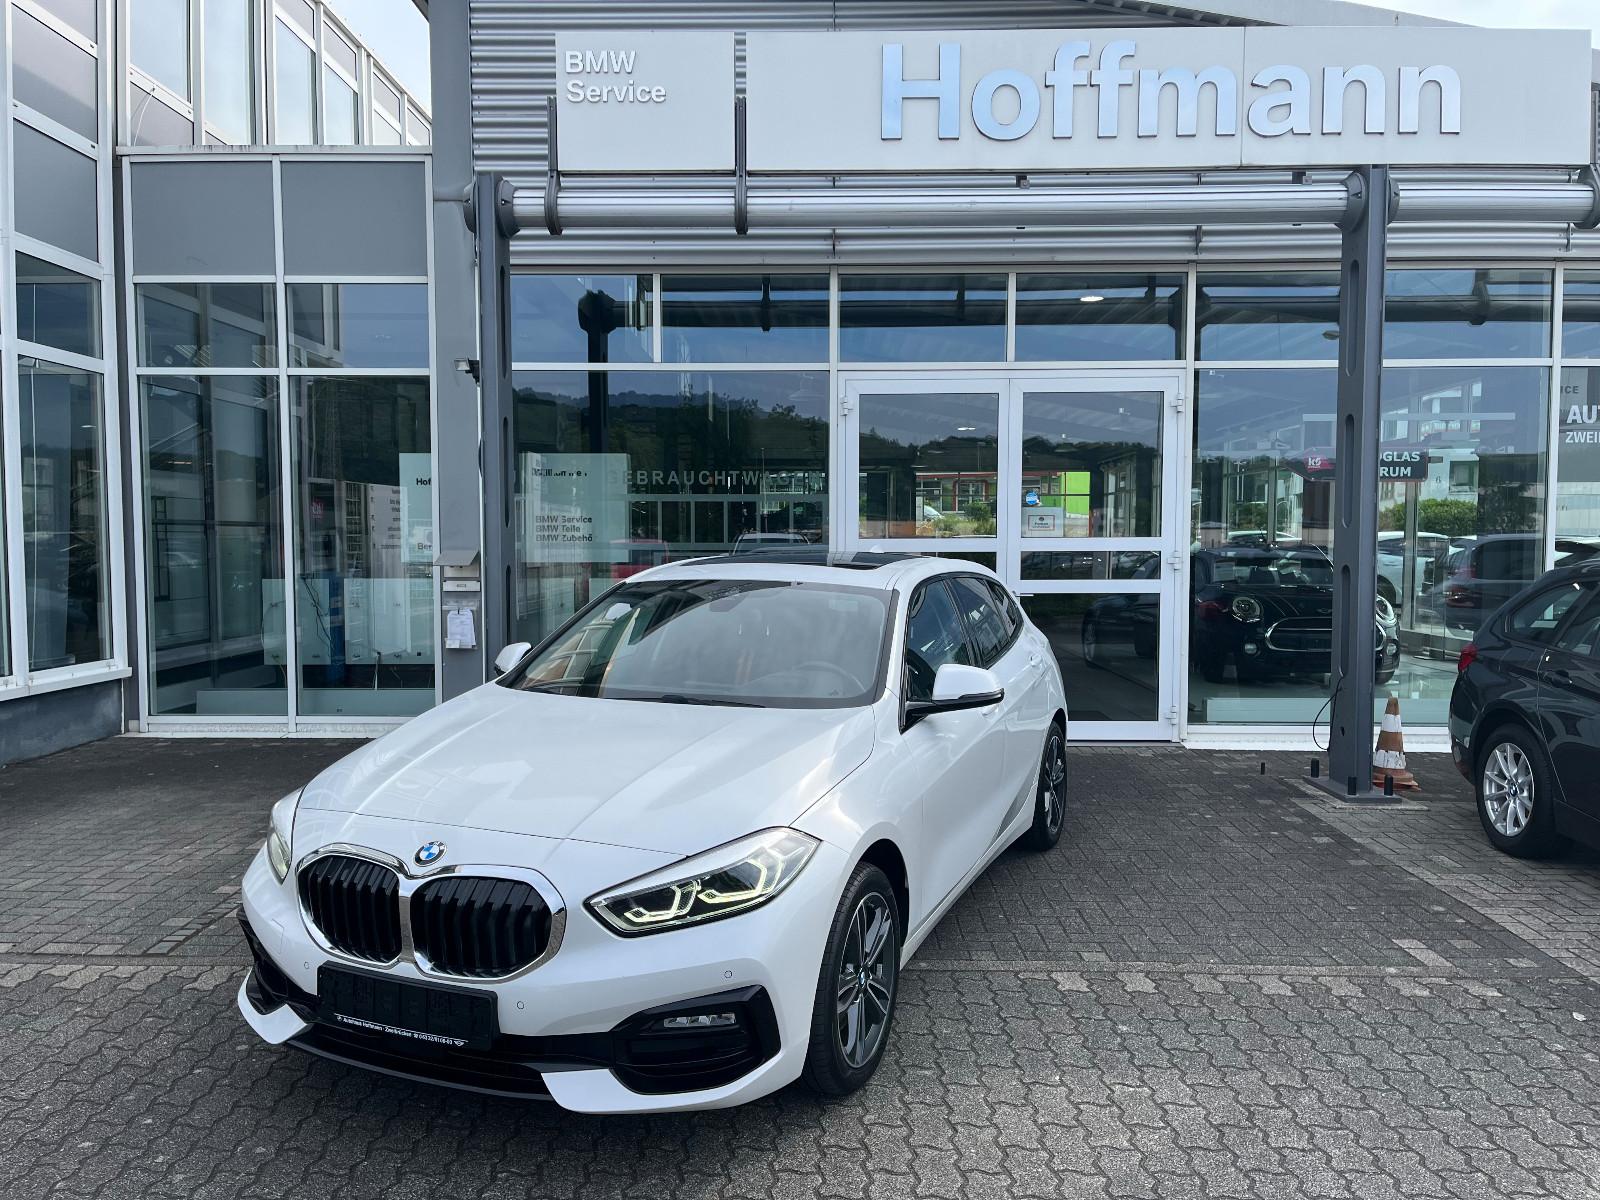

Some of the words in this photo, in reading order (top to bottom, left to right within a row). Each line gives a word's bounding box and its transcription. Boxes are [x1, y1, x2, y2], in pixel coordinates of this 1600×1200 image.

[564, 50, 636, 75] BMW
[566, 79, 667, 104] Service
[881, 39, 1462, 142] Hoffmann
[1566, 404, 1600, 424] AU
[1565, 431, 1600, 444] ZWEI
[1380, 451, 1420, 462] GLAS
[535, 515, 559, 524] BMW
[561, 515, 593, 524] Service
[535, 524, 559, 533] BMW
[535, 533, 559, 542] BMW
